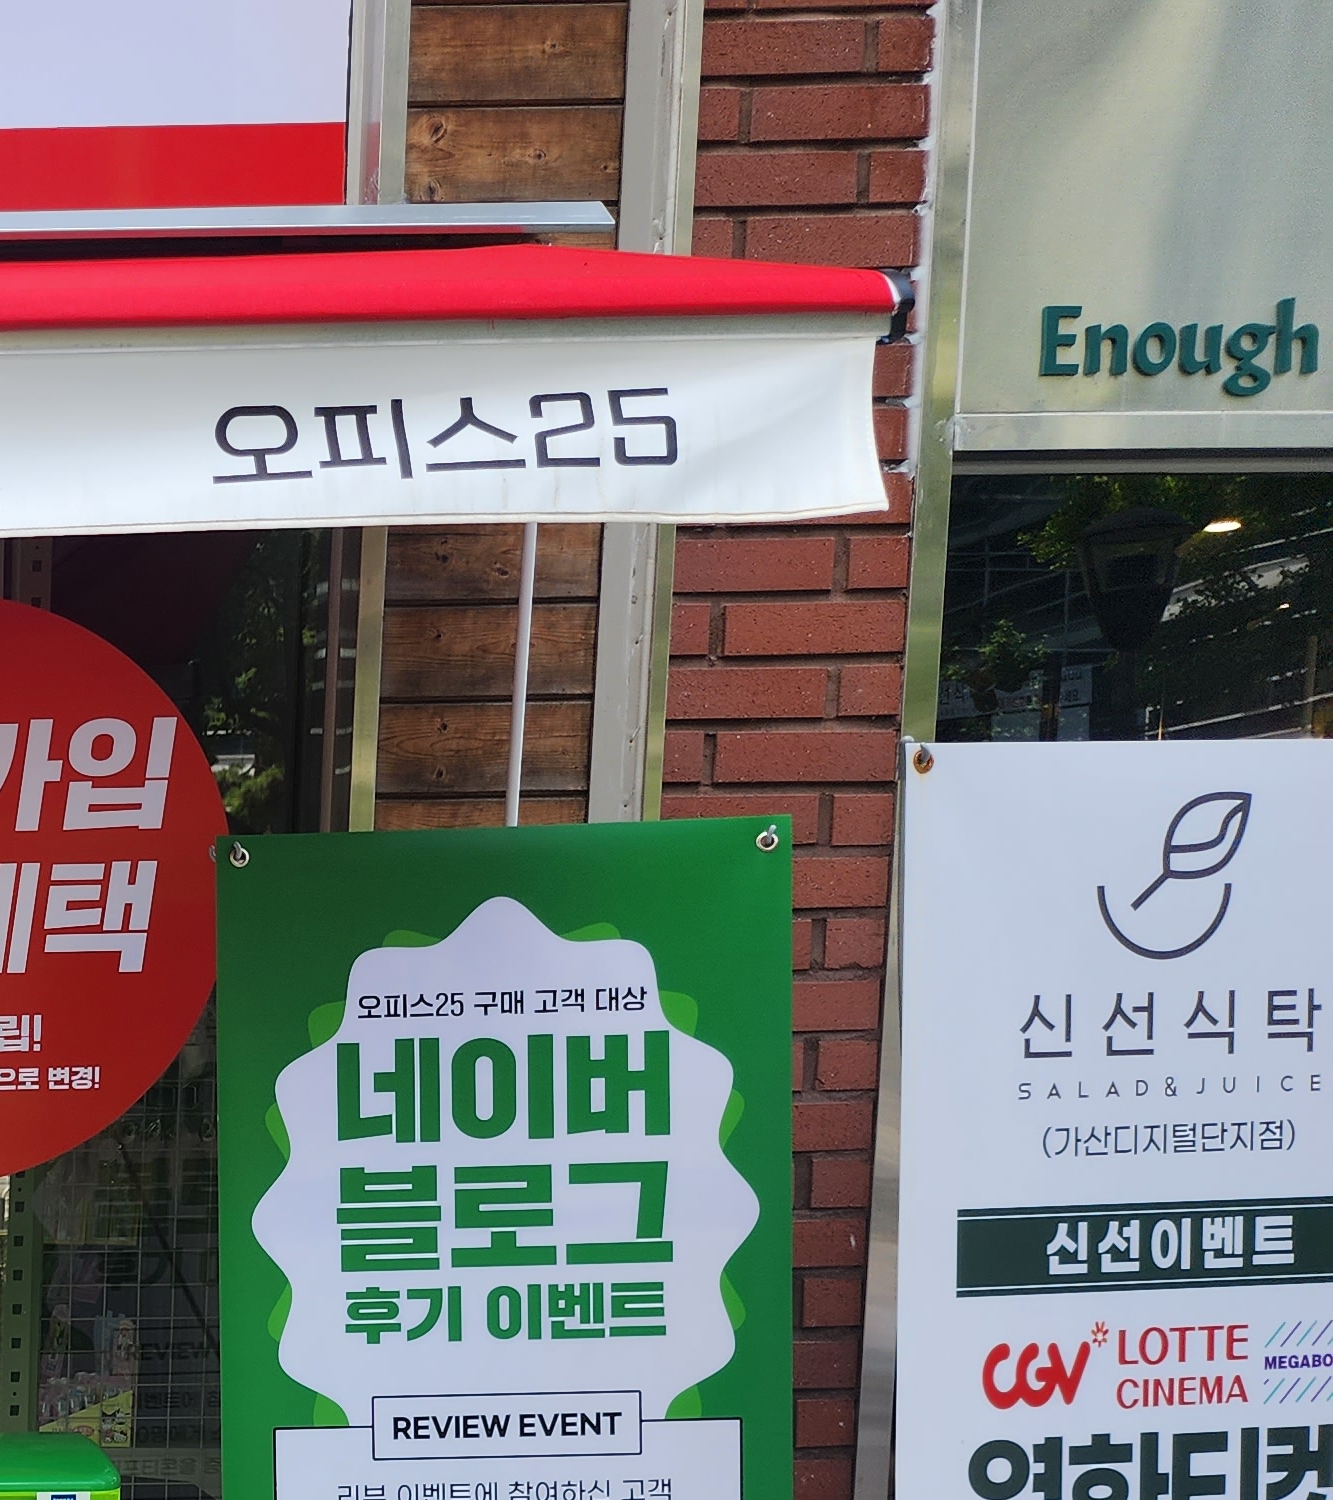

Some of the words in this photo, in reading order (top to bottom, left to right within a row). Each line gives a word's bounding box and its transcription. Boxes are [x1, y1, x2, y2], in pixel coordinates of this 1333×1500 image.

[1039, 297, 1319, 396] Enough
[213, 387, 678, 484] 오피스25
[357, 993, 464, 1020] 오피스25
[473, 990, 524, 1016] 구매
[534, 988, 585, 1014] 고객
[595, 986, 647, 1012] 대상
[1019, 988, 1322, 1059] 신선식탁
[47, 1065, 100, 1091] 변경!
[337, 1030, 671, 1143] 네이버
[1018, 1074, 1321, 1100] SALAD&JUICE
[1043, 1119, 1296, 1158] (가산디지털단지점)
[337, 1161, 673, 1272] 블로그
[1046, 1215, 1294, 1276] 신선이벤트
[345, 1286, 462, 1344] 후기
[486, 1282, 667, 1340] 이벤트
[982, 1341, 1091, 1410] CGV
[1118, 1324, 1249, 1367] LOTTE
[1116, 1375, 1248, 1409] CINEMA
[393, 1415, 511, 1440] REVIEW
[519, 1412, 622, 1437] EVENT
